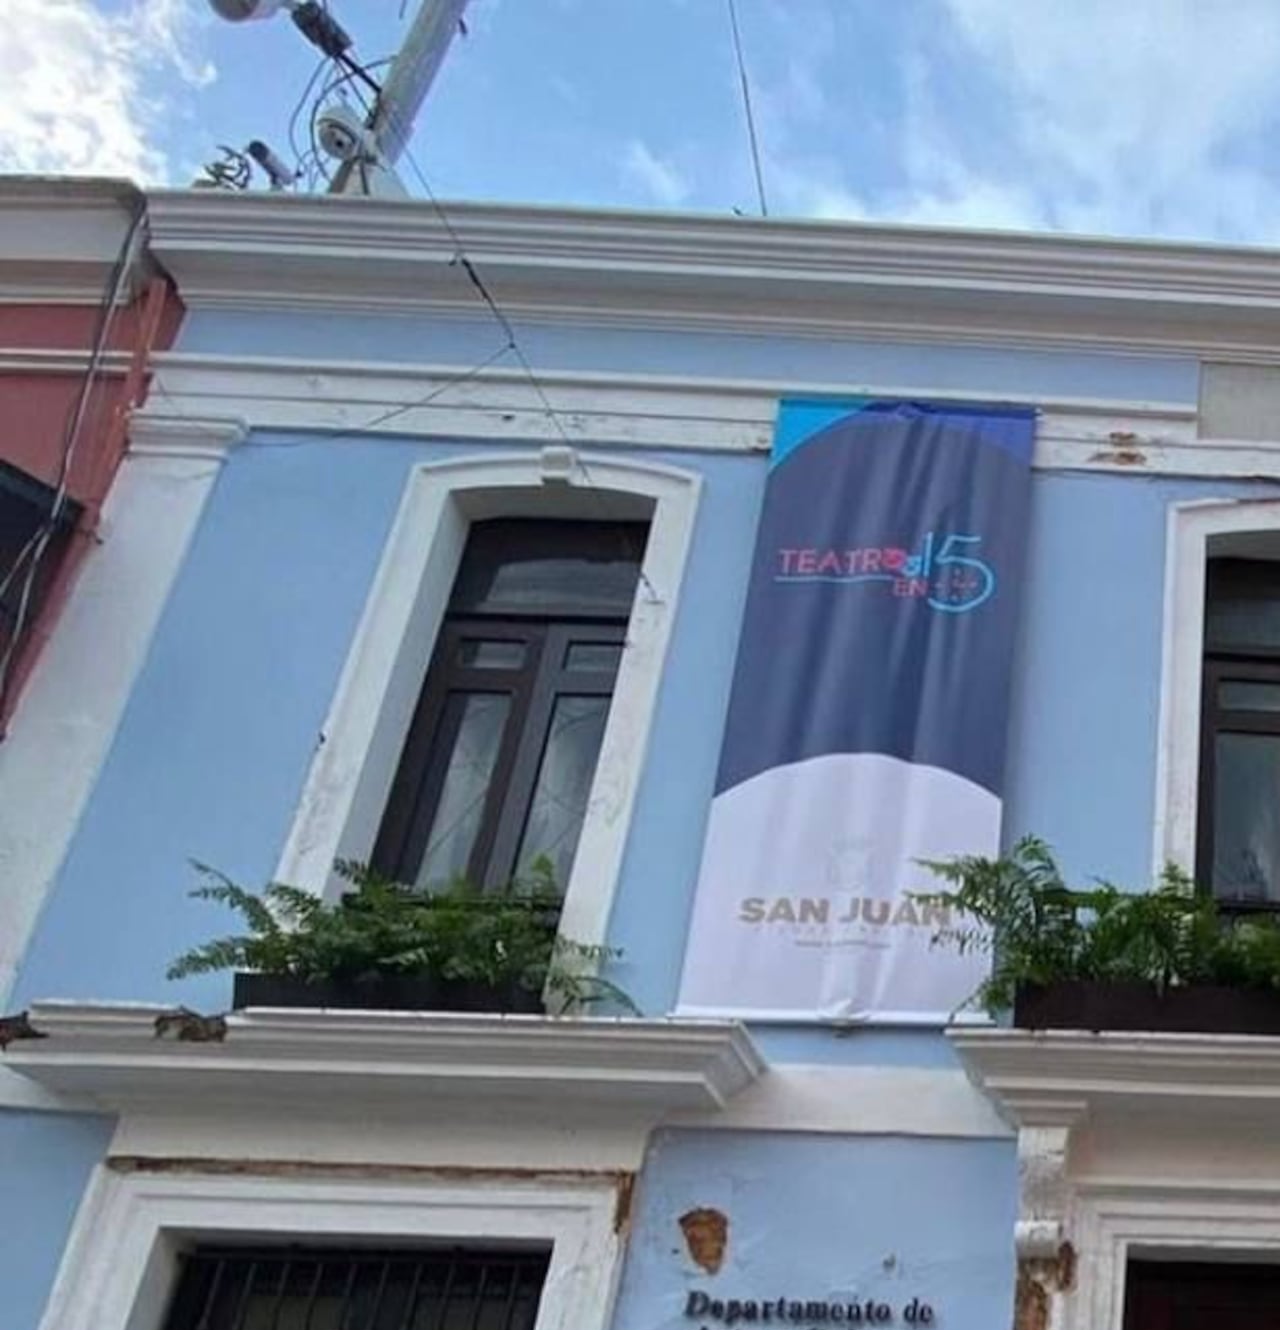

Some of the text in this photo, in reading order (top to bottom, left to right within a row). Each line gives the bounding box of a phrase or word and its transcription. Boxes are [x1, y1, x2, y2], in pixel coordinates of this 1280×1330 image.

[738, 897, 951, 927] SAN JUAN
[684, 1290, 934, 1325] Departamento de
